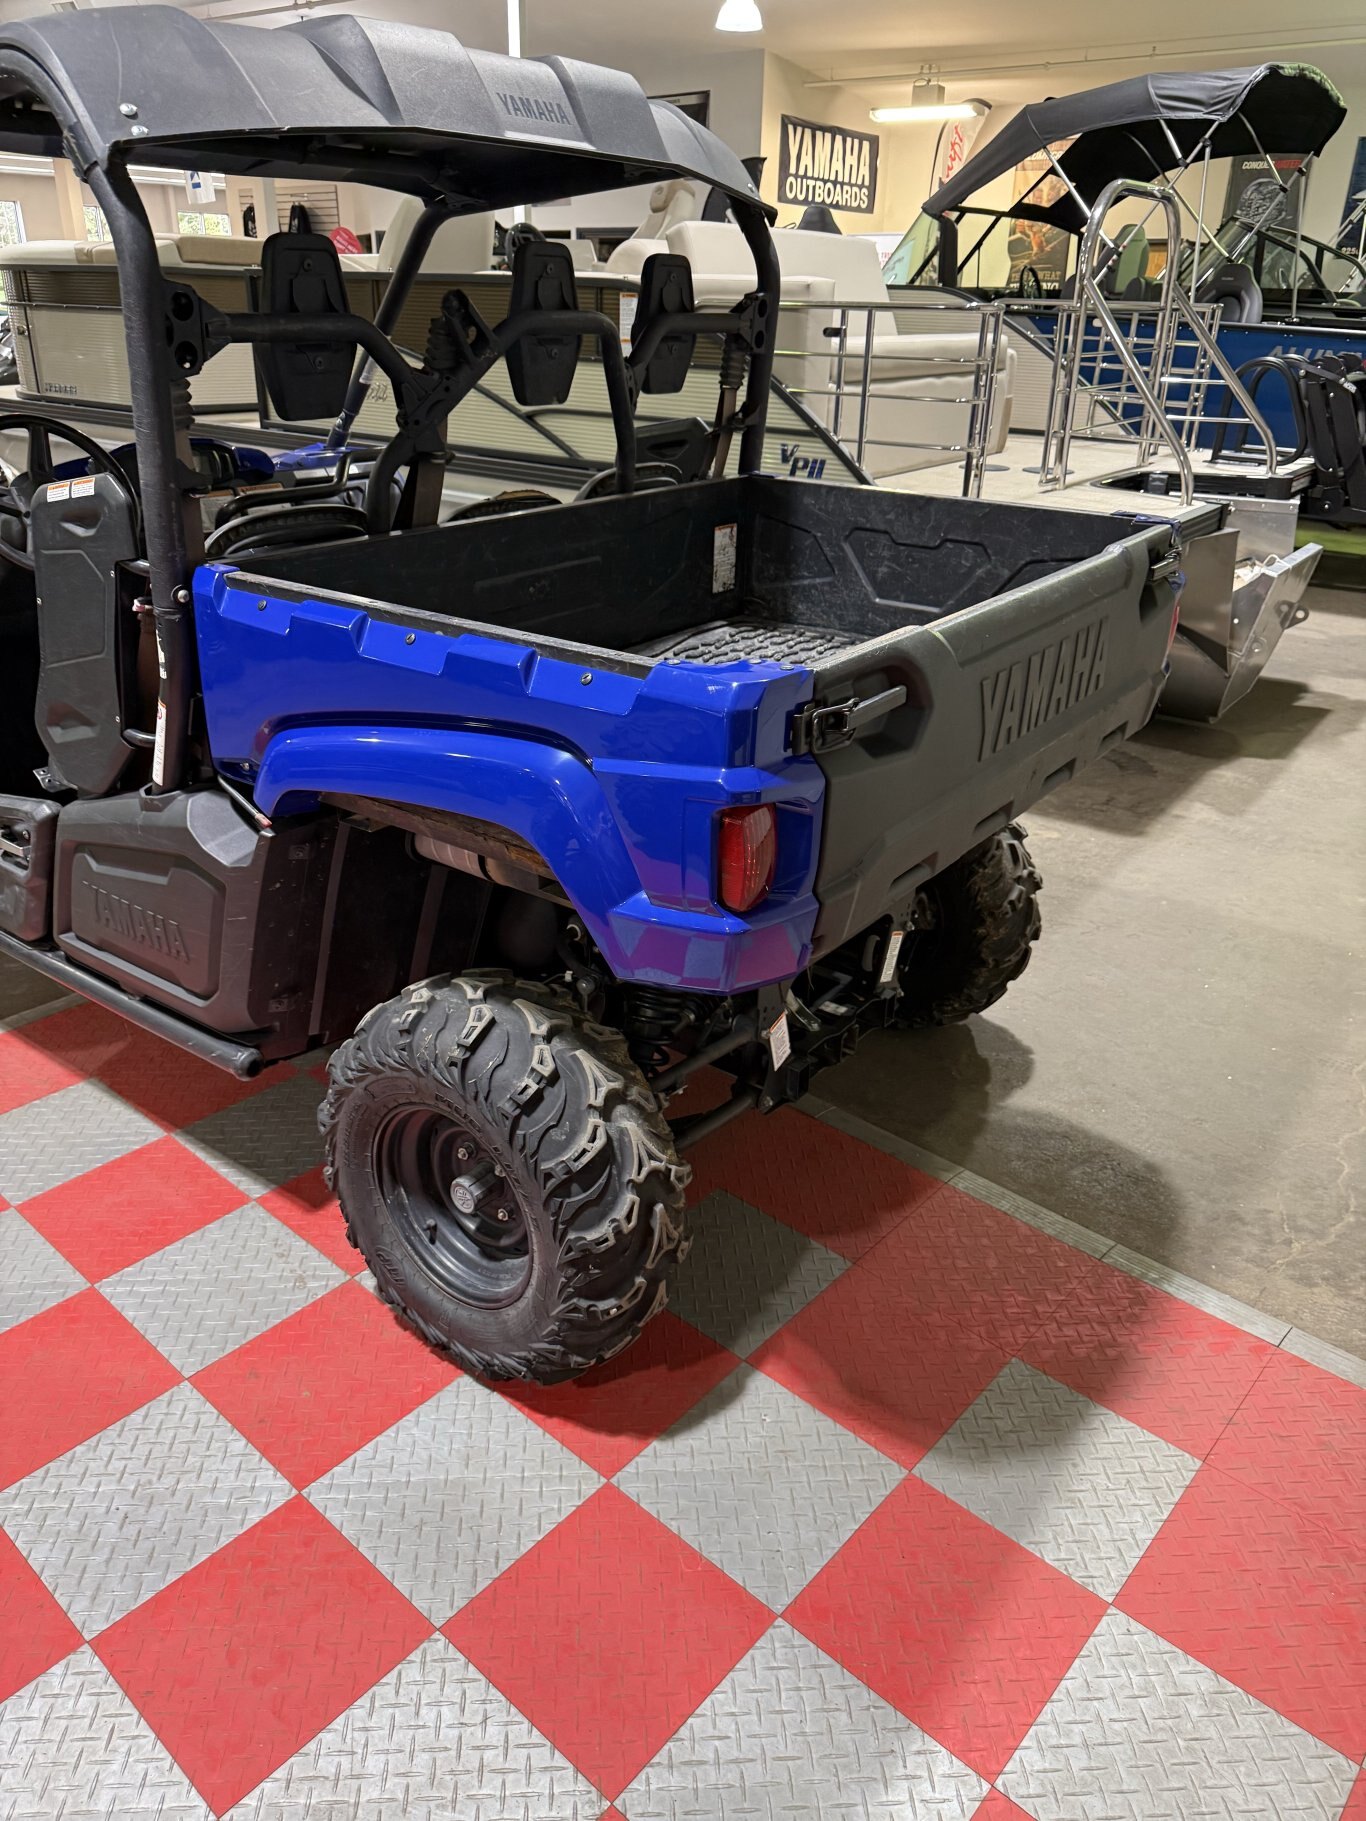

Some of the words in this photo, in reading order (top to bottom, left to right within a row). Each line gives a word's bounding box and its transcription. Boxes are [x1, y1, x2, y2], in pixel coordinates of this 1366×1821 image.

[496, 92, 573, 126] YAMAHA
[787, 124, 870, 186] YAMAHA
[1242, 160, 1275, 170] CONQU
[785, 176, 869, 209] OUTBOARDS
[977, 615, 1109, 763] YAMAHA
[82, 880, 190, 964] YAMAHA
